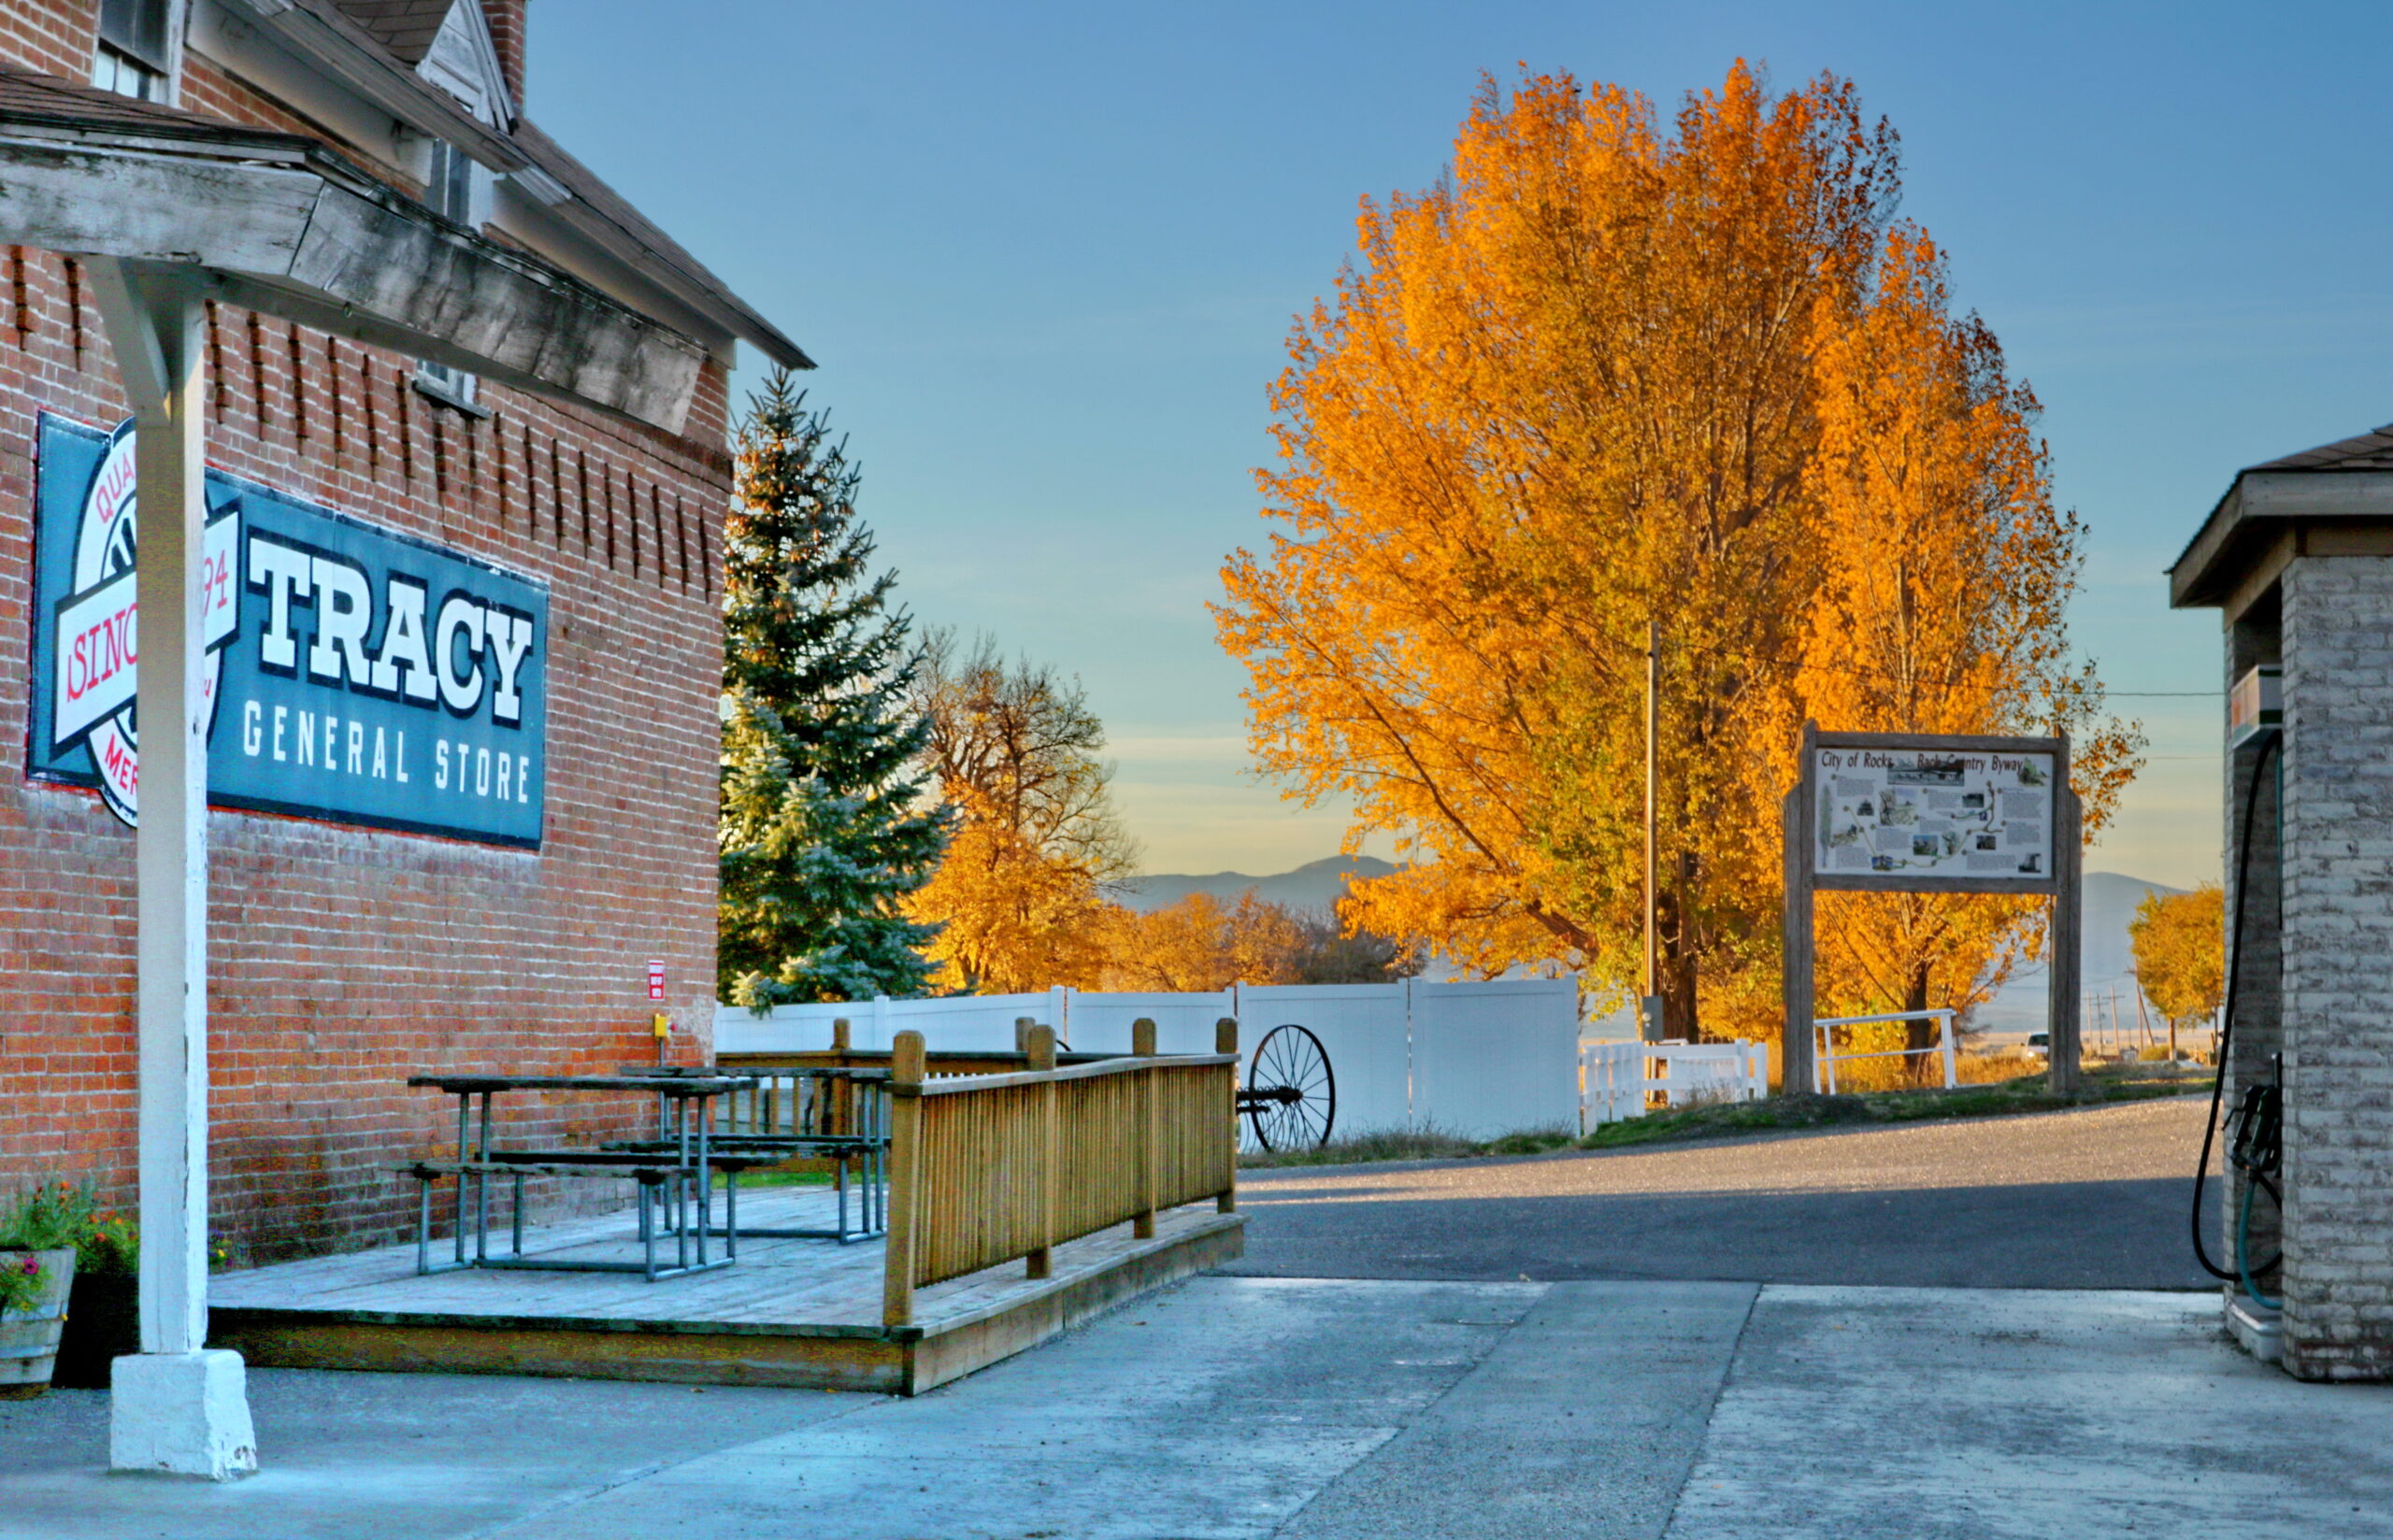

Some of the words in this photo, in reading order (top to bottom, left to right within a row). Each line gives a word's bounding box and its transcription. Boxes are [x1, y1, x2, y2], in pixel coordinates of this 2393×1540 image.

[66, 601, 138, 703] SINC
[249, 535, 534, 722] TRACY
[243, 699, 409, 784] GENERAL
[435, 738, 530, 805] STORE
[1821, 750, 1842, 772] City
[1847, 751, 1859, 768] of
[1863, 751, 1893, 769] Rocks
[1947, 753, 1986, 775] Cntry
[1991, 755, 2025, 777] Byway
